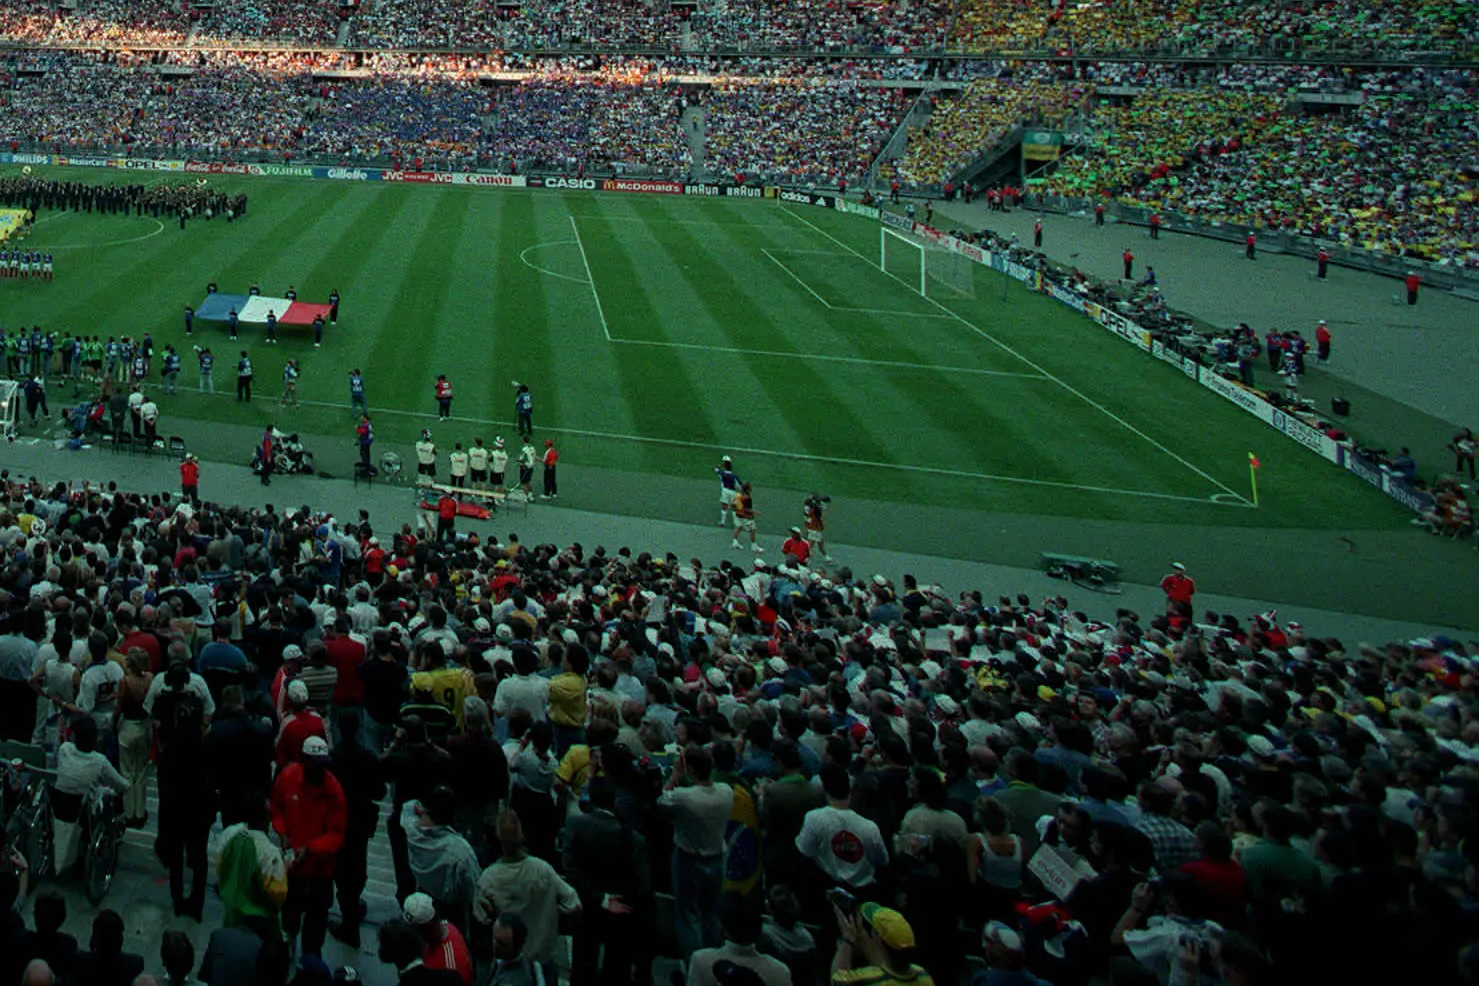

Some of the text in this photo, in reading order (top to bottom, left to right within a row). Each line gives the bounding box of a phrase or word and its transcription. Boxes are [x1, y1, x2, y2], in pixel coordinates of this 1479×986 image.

[12, 154, 49, 164] PHILIPS
[124, 160, 158, 170] OPEL
[266, 167, 312, 176] FUJIFILM
[328, 168, 368, 180] Gillette
[382, 171, 404, 181] JVC
[430, 173, 452, 183] JVC
[466, 175, 512, 186] Canon
[544, 178, 596, 190] CASIO
[616, 181, 681, 193] McDonald's
[684, 184, 719, 196] BRAUN
[726, 185, 761, 198] BRAUN
[781, 191, 811, 203] adidas
[1100, 309, 1132, 340] OPEL
